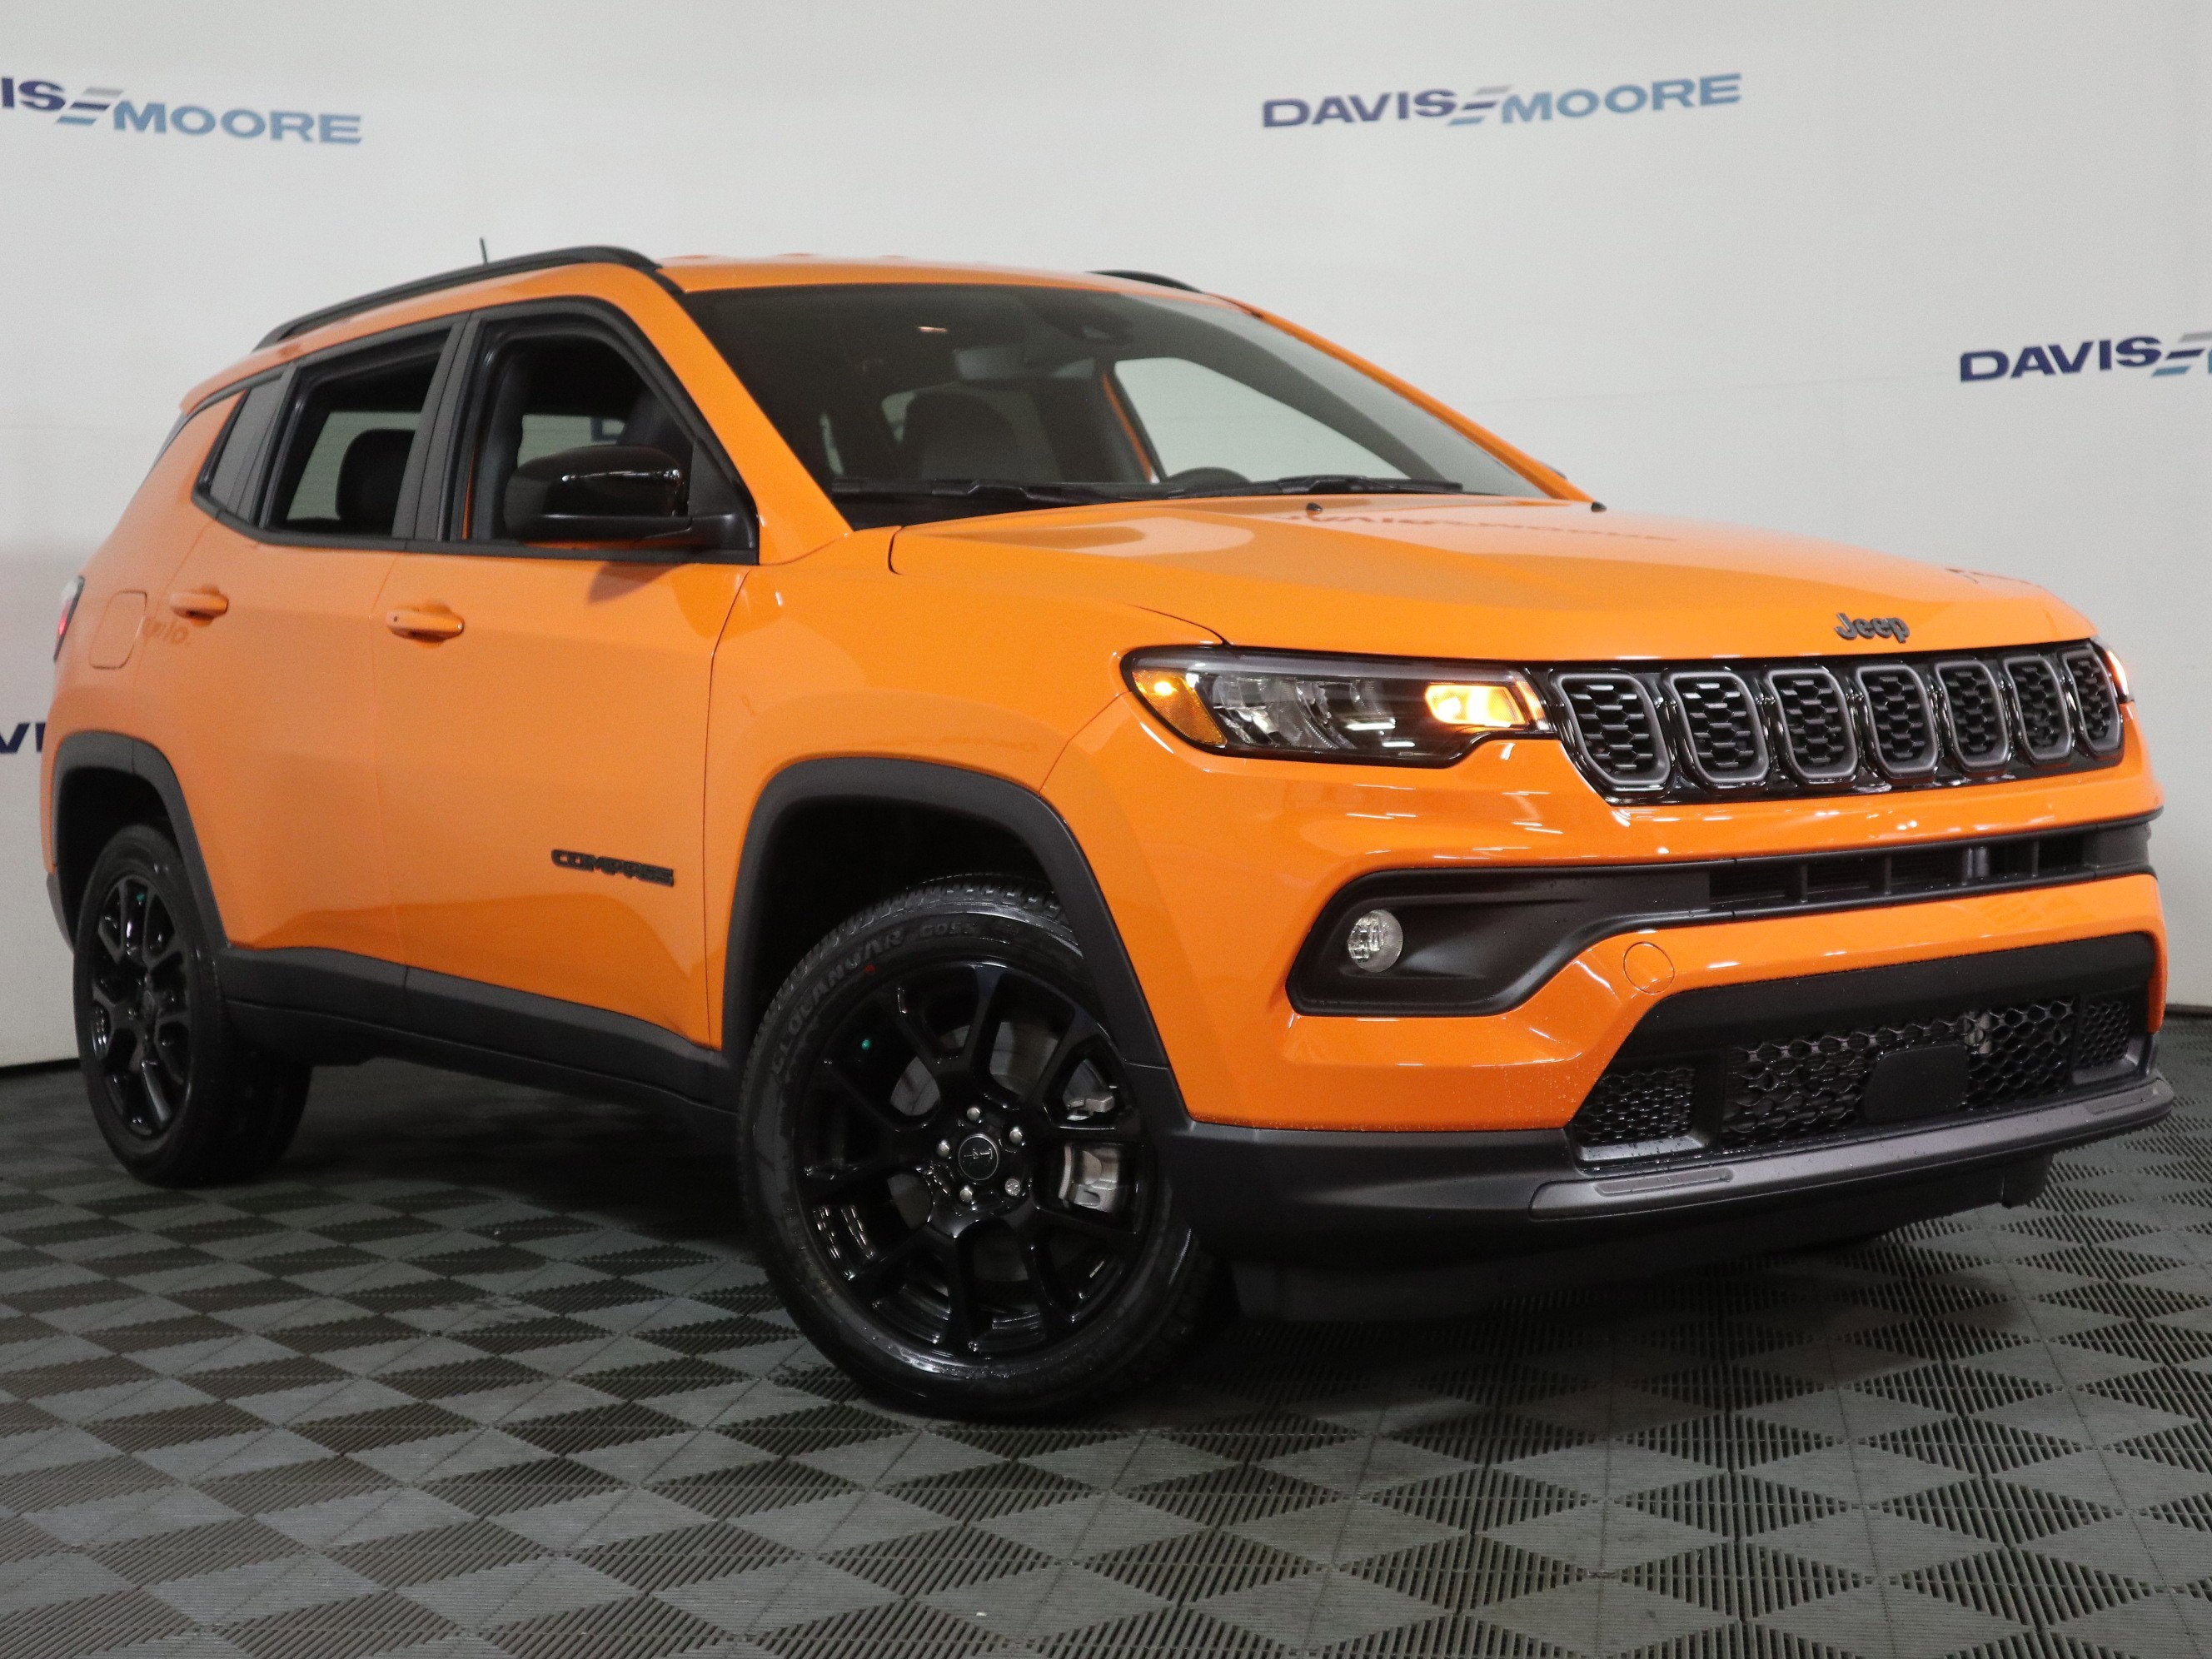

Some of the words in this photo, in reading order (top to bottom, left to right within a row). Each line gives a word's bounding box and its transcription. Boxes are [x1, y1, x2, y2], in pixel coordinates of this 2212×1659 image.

[113, 100, 361, 145] MOORE
[1263, 88, 1457, 128] DAVIS
[1502, 72, 1741, 124] MOORE
[1960, 336, 2162, 382] DAVIS
[1835, 612, 1910, 644] Jeep
